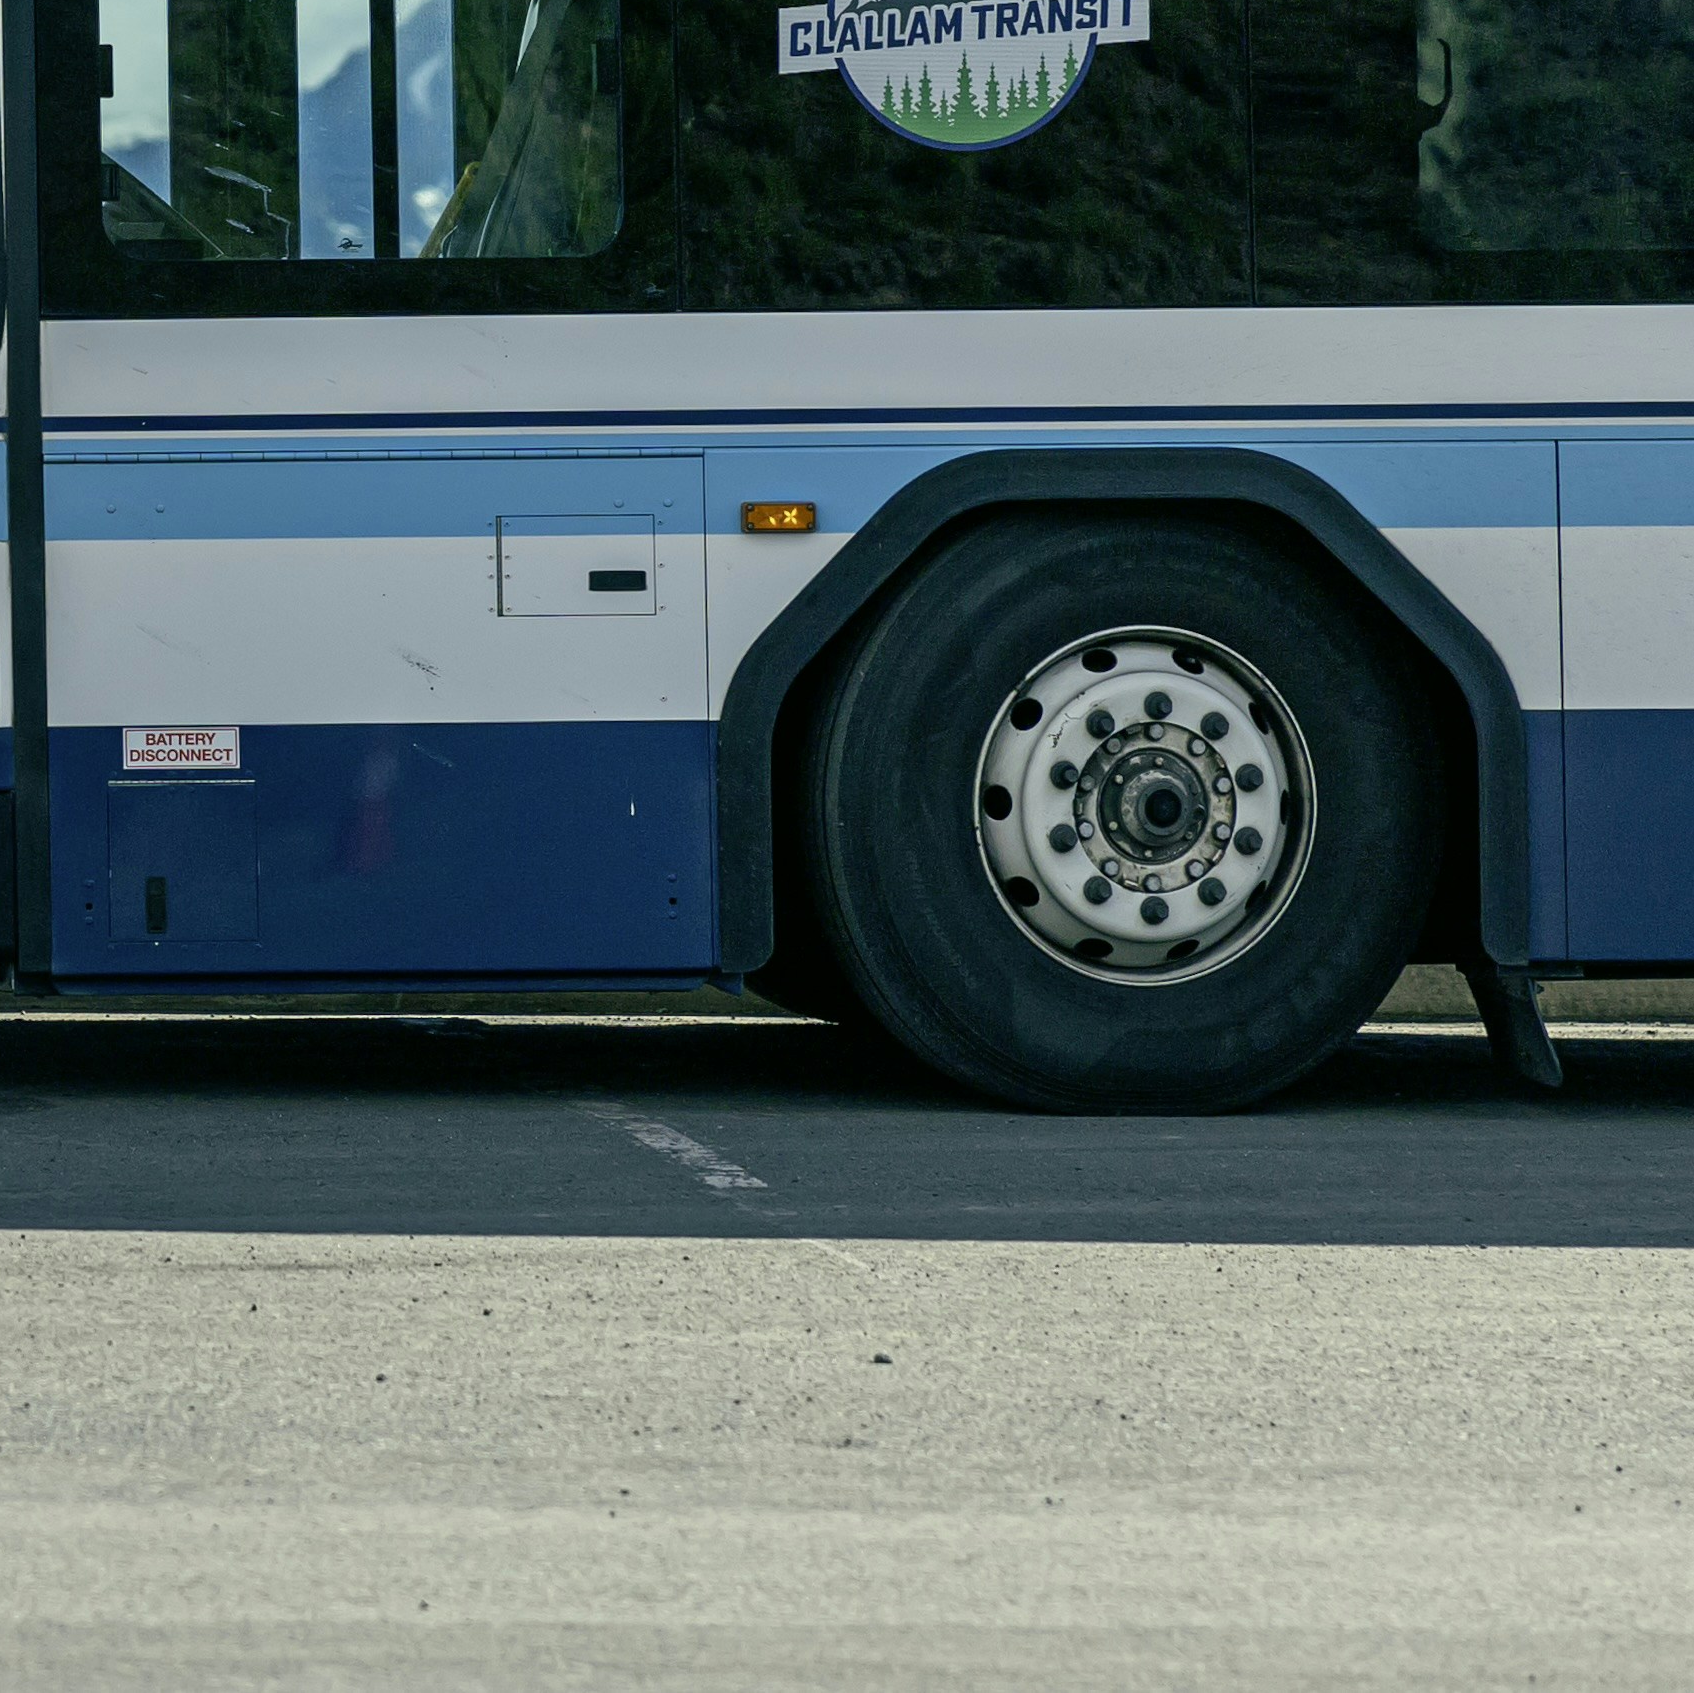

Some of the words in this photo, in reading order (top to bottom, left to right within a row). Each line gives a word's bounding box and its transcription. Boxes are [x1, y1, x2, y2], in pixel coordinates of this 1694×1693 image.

[789, 5, 963, 57] CLALLAM
[145, 732, 216, 746] BATTERY
[129, 748, 233, 762] DISCONNECT
